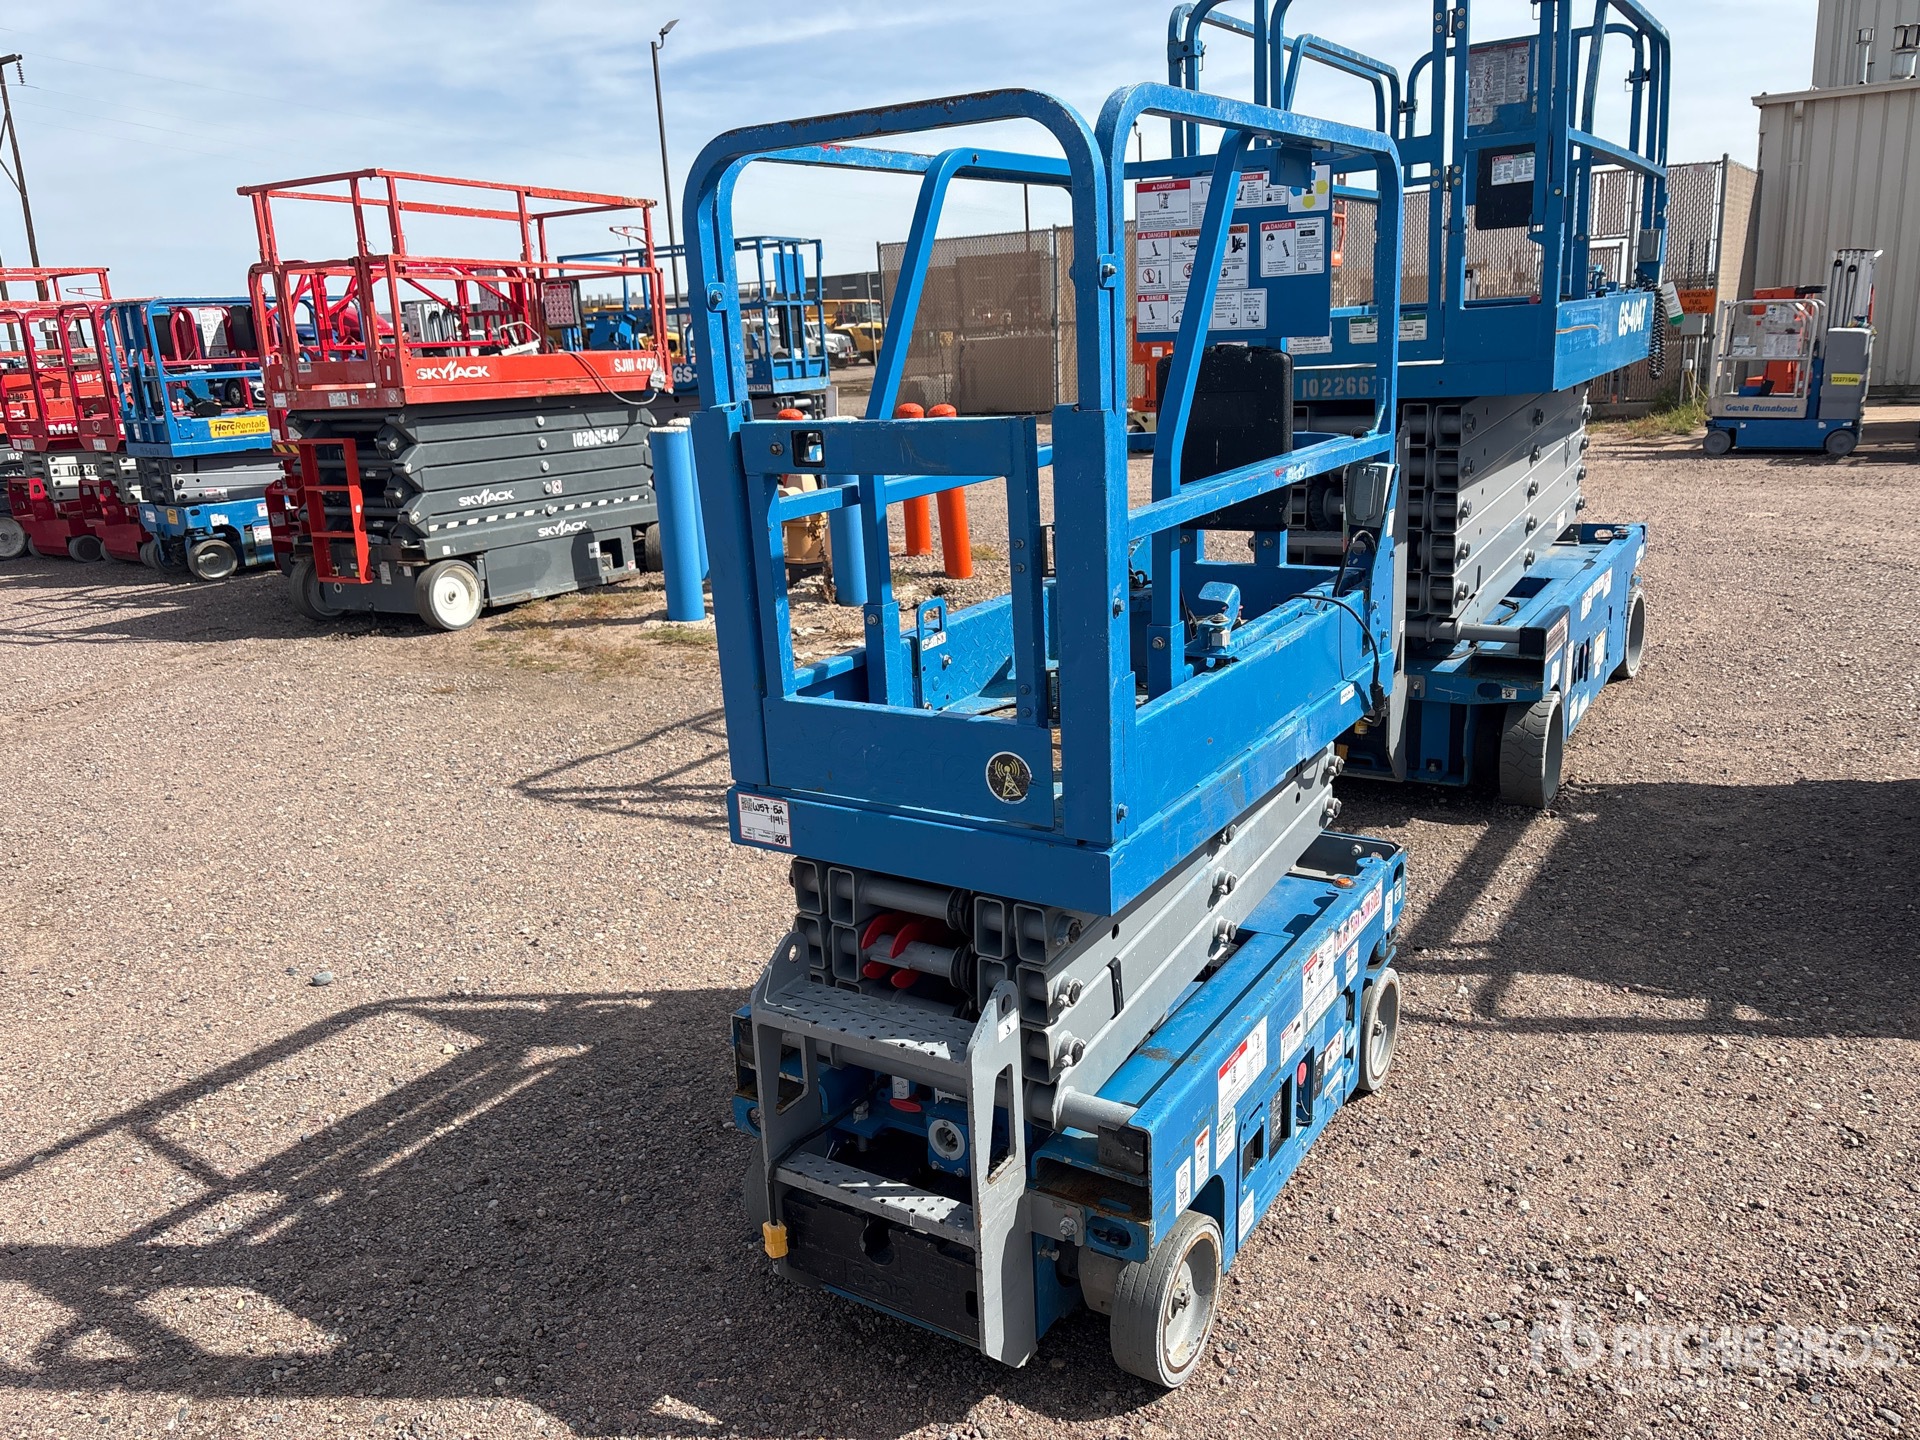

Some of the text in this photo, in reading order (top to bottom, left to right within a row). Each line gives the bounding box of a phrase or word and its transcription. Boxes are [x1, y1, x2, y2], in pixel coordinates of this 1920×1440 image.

[1270, 222, 1292, 230] DANGER
[1618, 298, 1648, 337] GS-4047
[416, 361, 491, 381] SKYJACK
[1725, 403, 1798, 413] Genie Runabout
[215, 420, 266, 432] HercRentals
[458, 488, 515, 507] SKYJACK
[537, 520, 587, 538] SKYJACK
